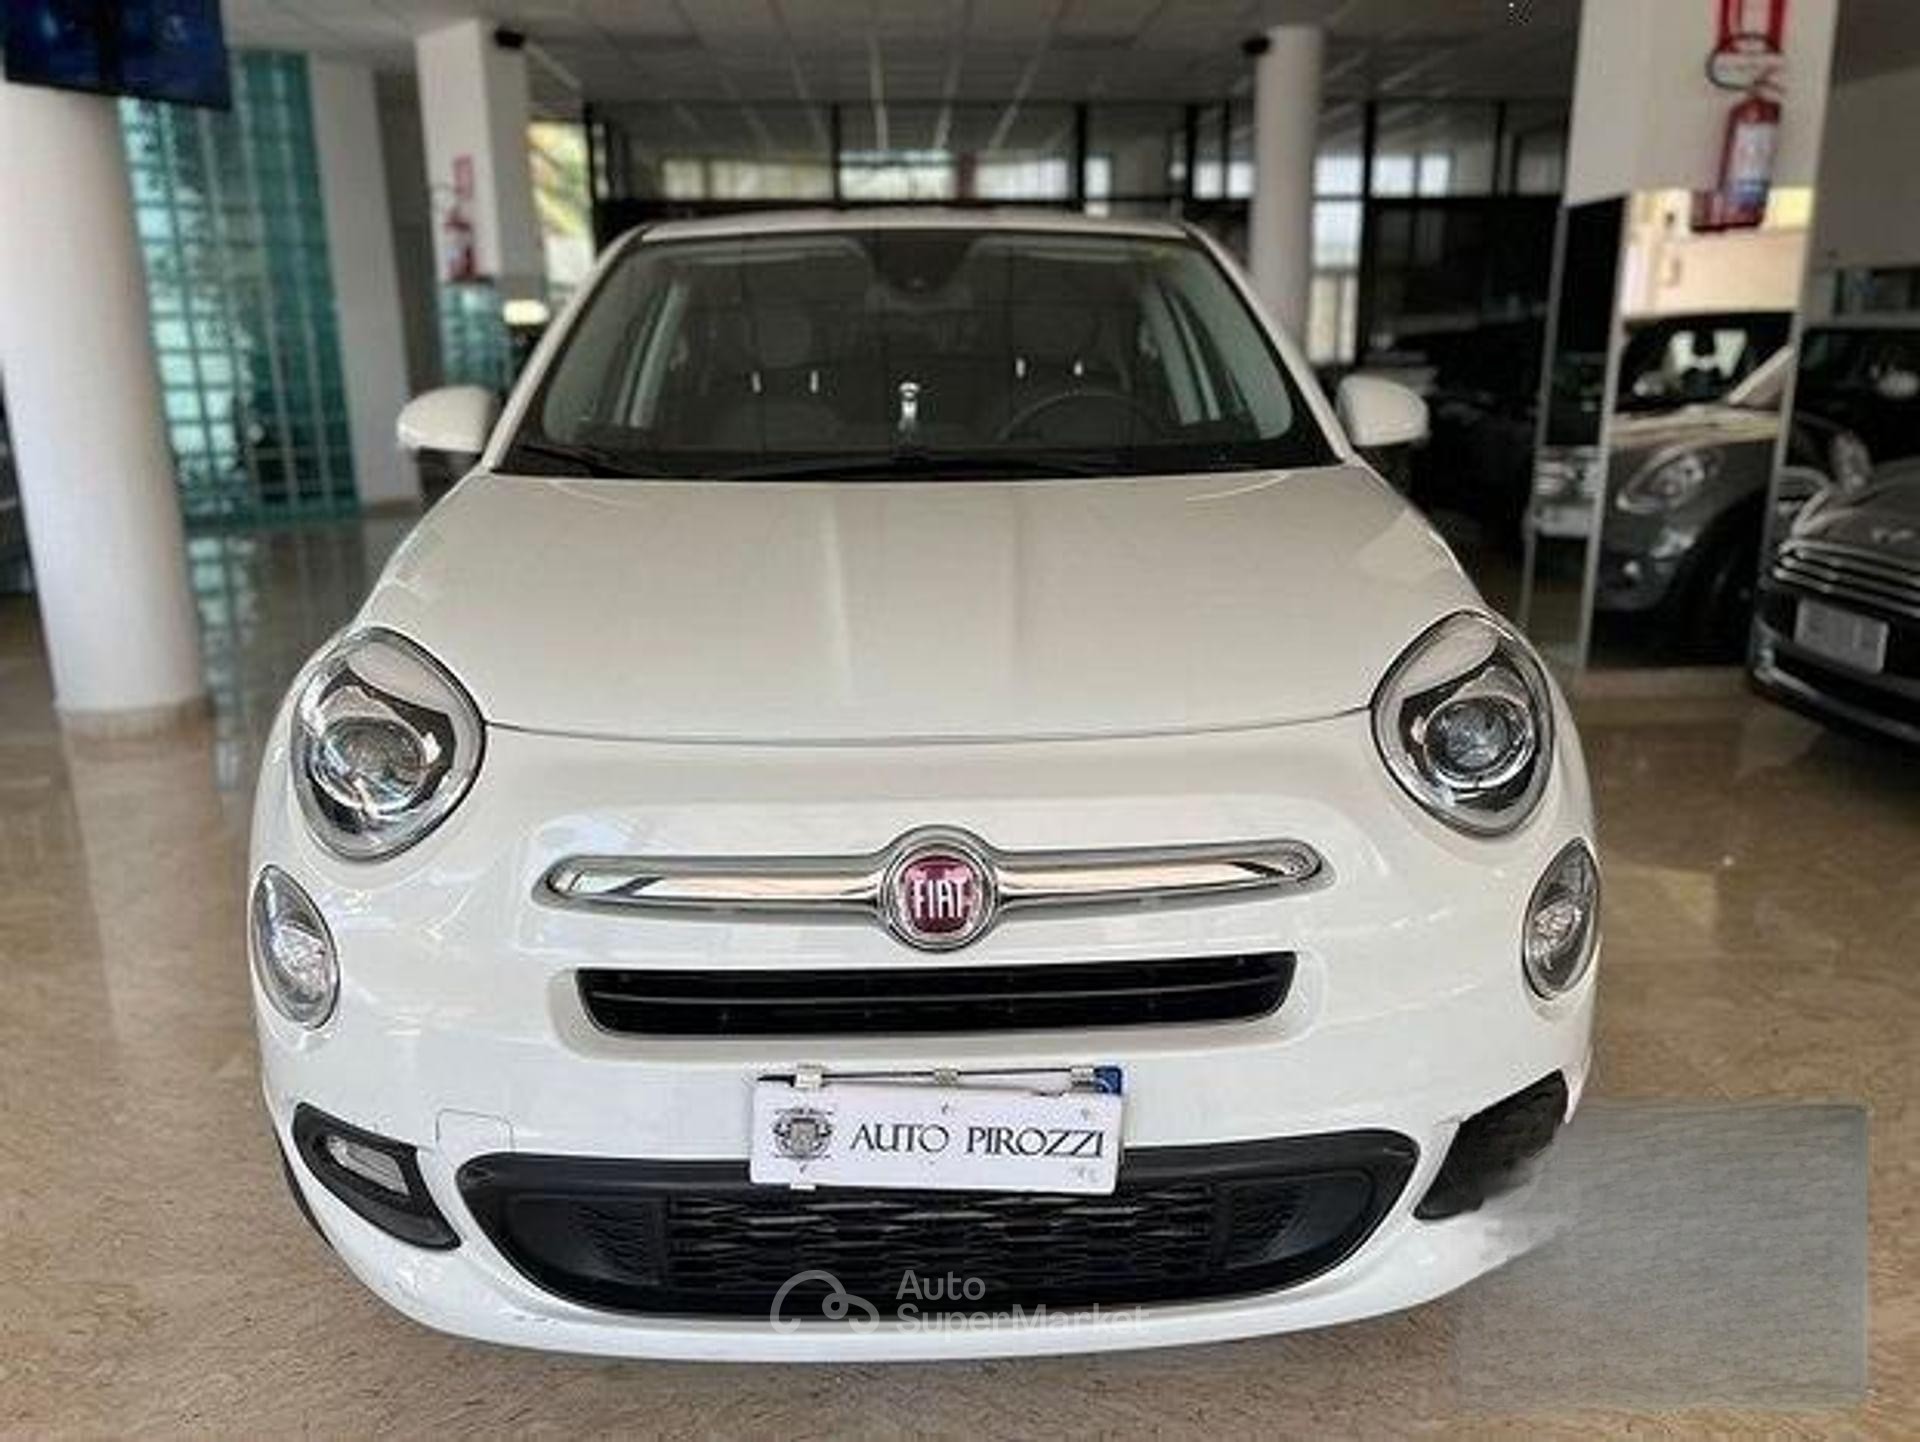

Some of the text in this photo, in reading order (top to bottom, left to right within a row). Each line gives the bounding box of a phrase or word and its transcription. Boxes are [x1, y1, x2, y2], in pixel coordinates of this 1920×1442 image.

[908, 867, 968, 919] FIAT
[850, 1123, 1104, 1158] AUTO PIROZZI
